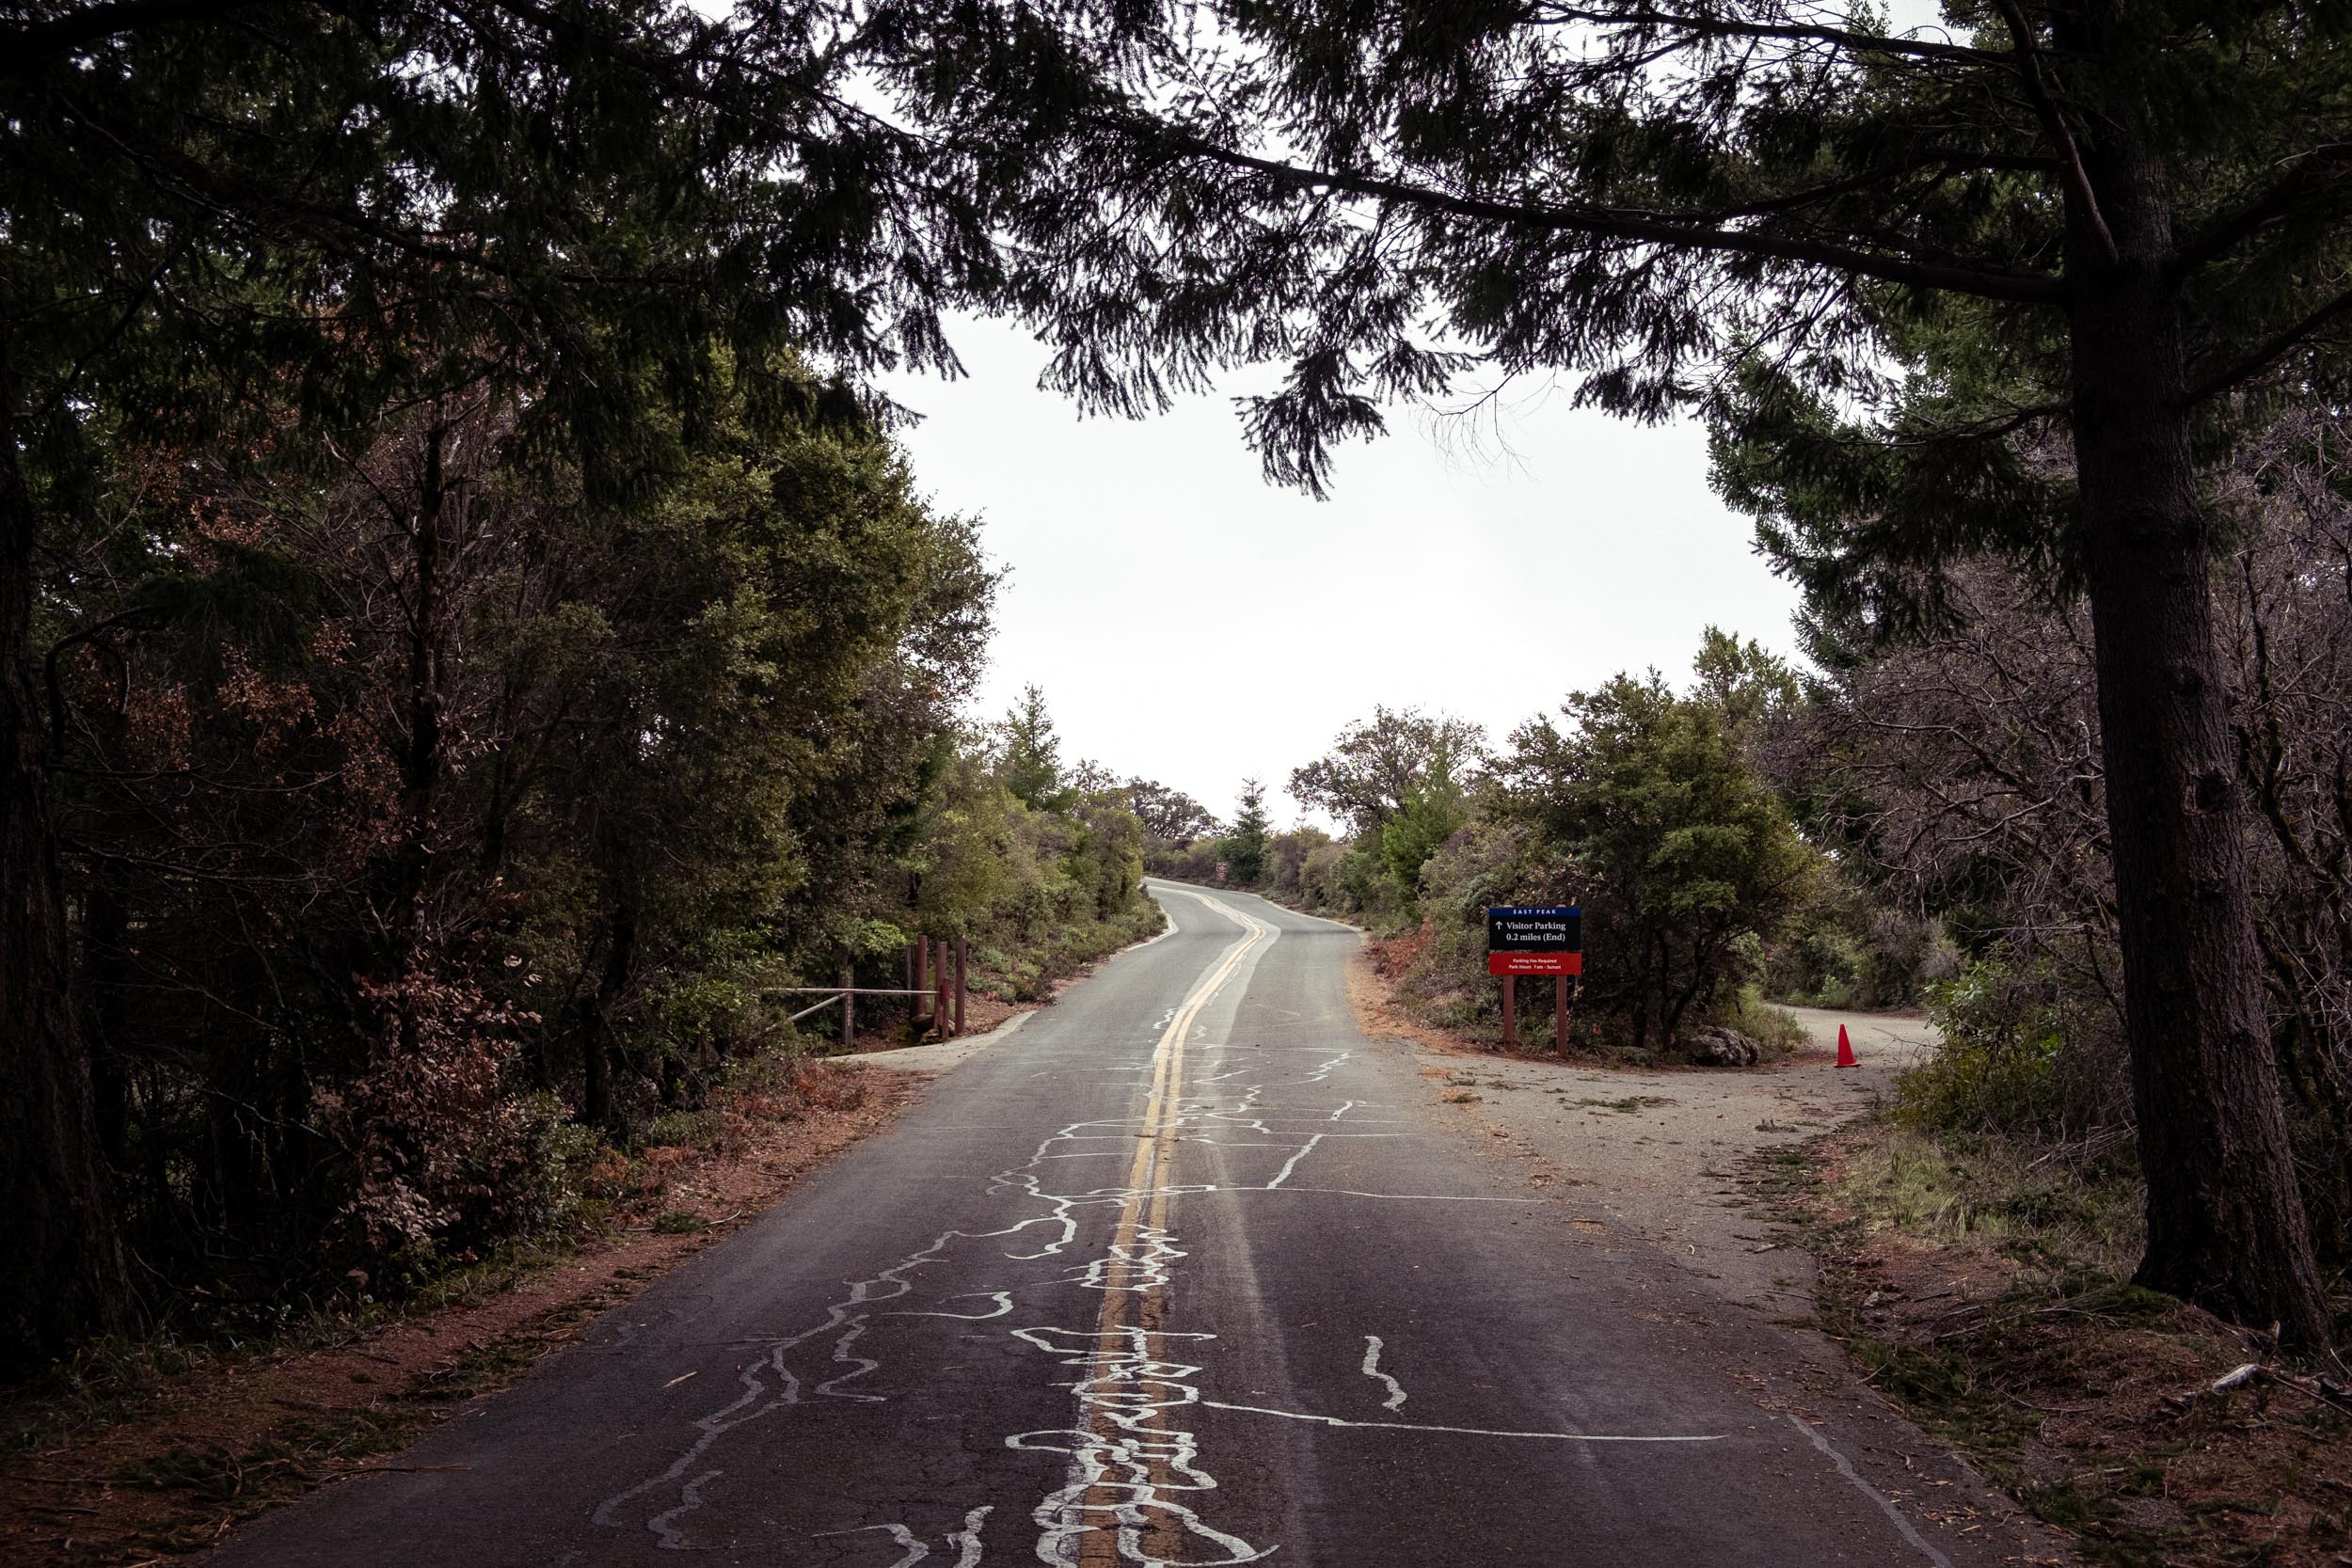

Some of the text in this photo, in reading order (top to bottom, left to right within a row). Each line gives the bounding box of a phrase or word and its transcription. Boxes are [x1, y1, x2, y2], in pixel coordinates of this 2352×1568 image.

[1506, 922, 1566, 931] Visitor Parking
[1506, 933, 1565, 942] 0.2 miles (End)
